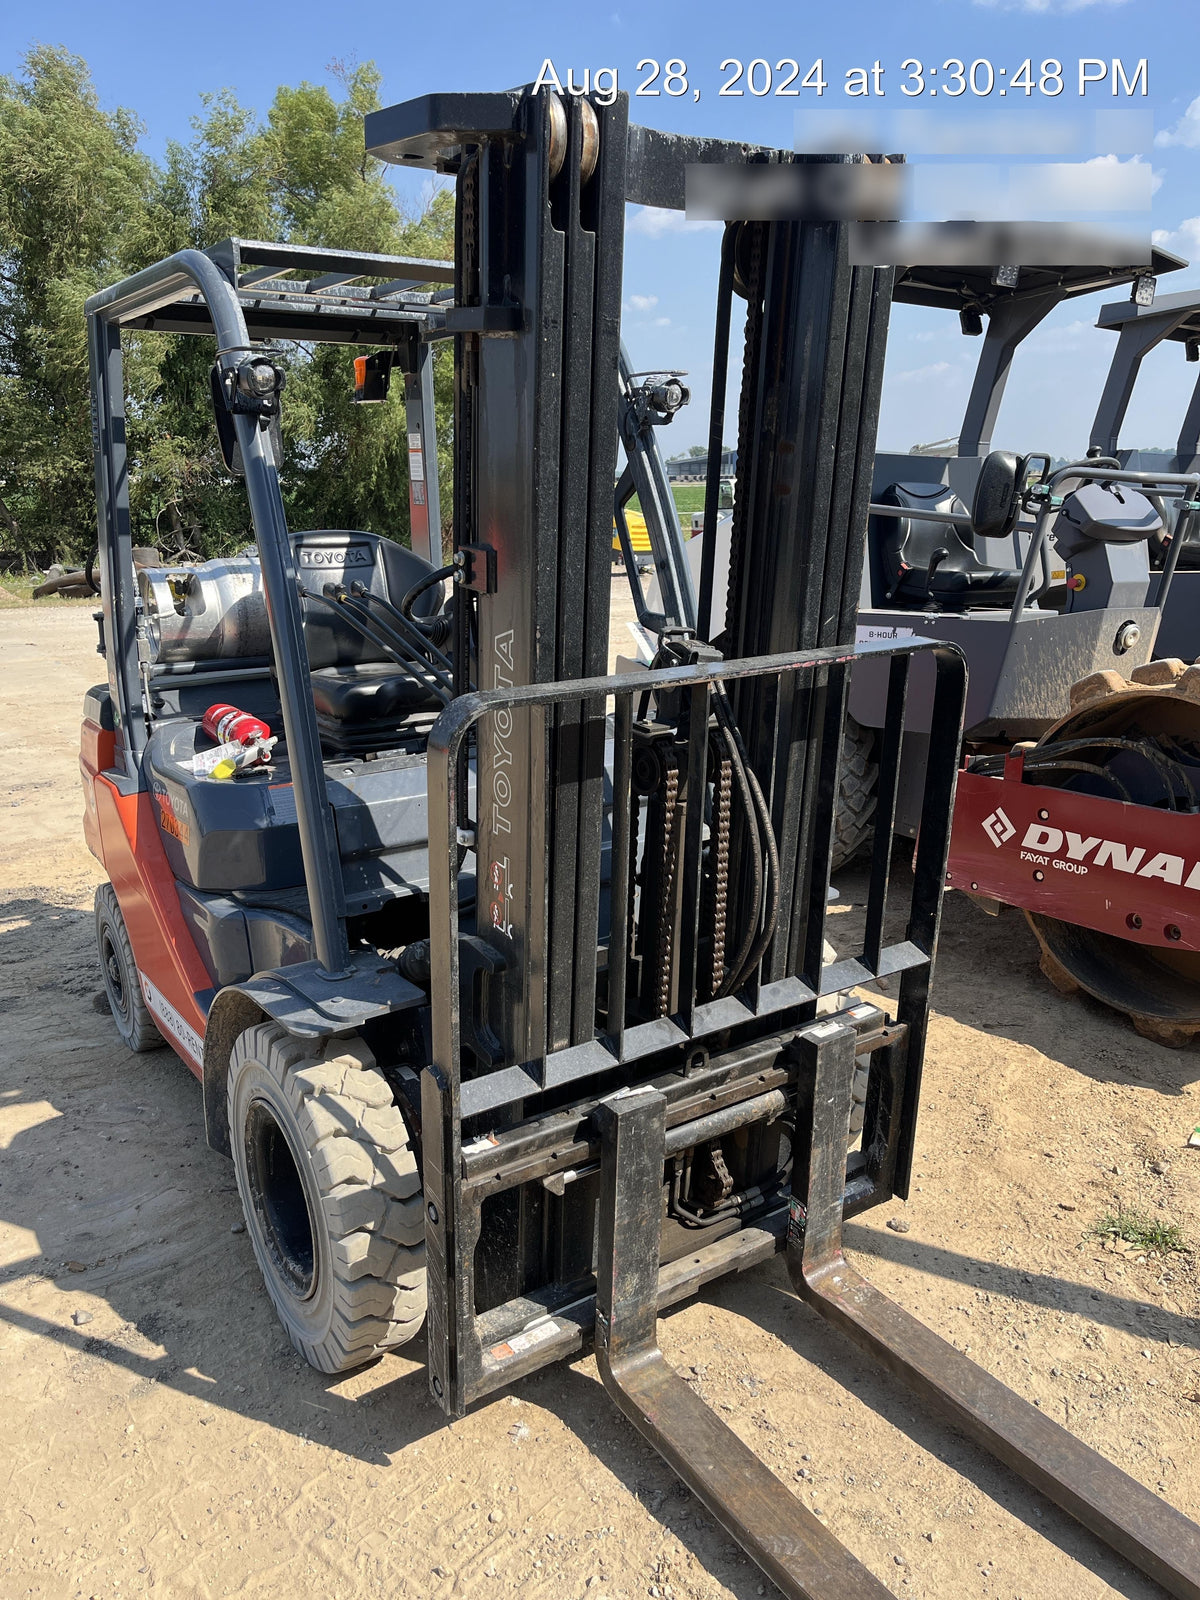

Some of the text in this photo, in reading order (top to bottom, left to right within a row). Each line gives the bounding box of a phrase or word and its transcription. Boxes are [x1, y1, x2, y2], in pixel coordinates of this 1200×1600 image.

[301, 551, 367, 564] TOYOTA
[868, 631, 898, 639] 8-HOUR
[492, 629, 514, 835] TOYOTA
[162, 787, 189, 817] TOYOTA
[1020, 851, 1088, 875] FAYAT GROUP
